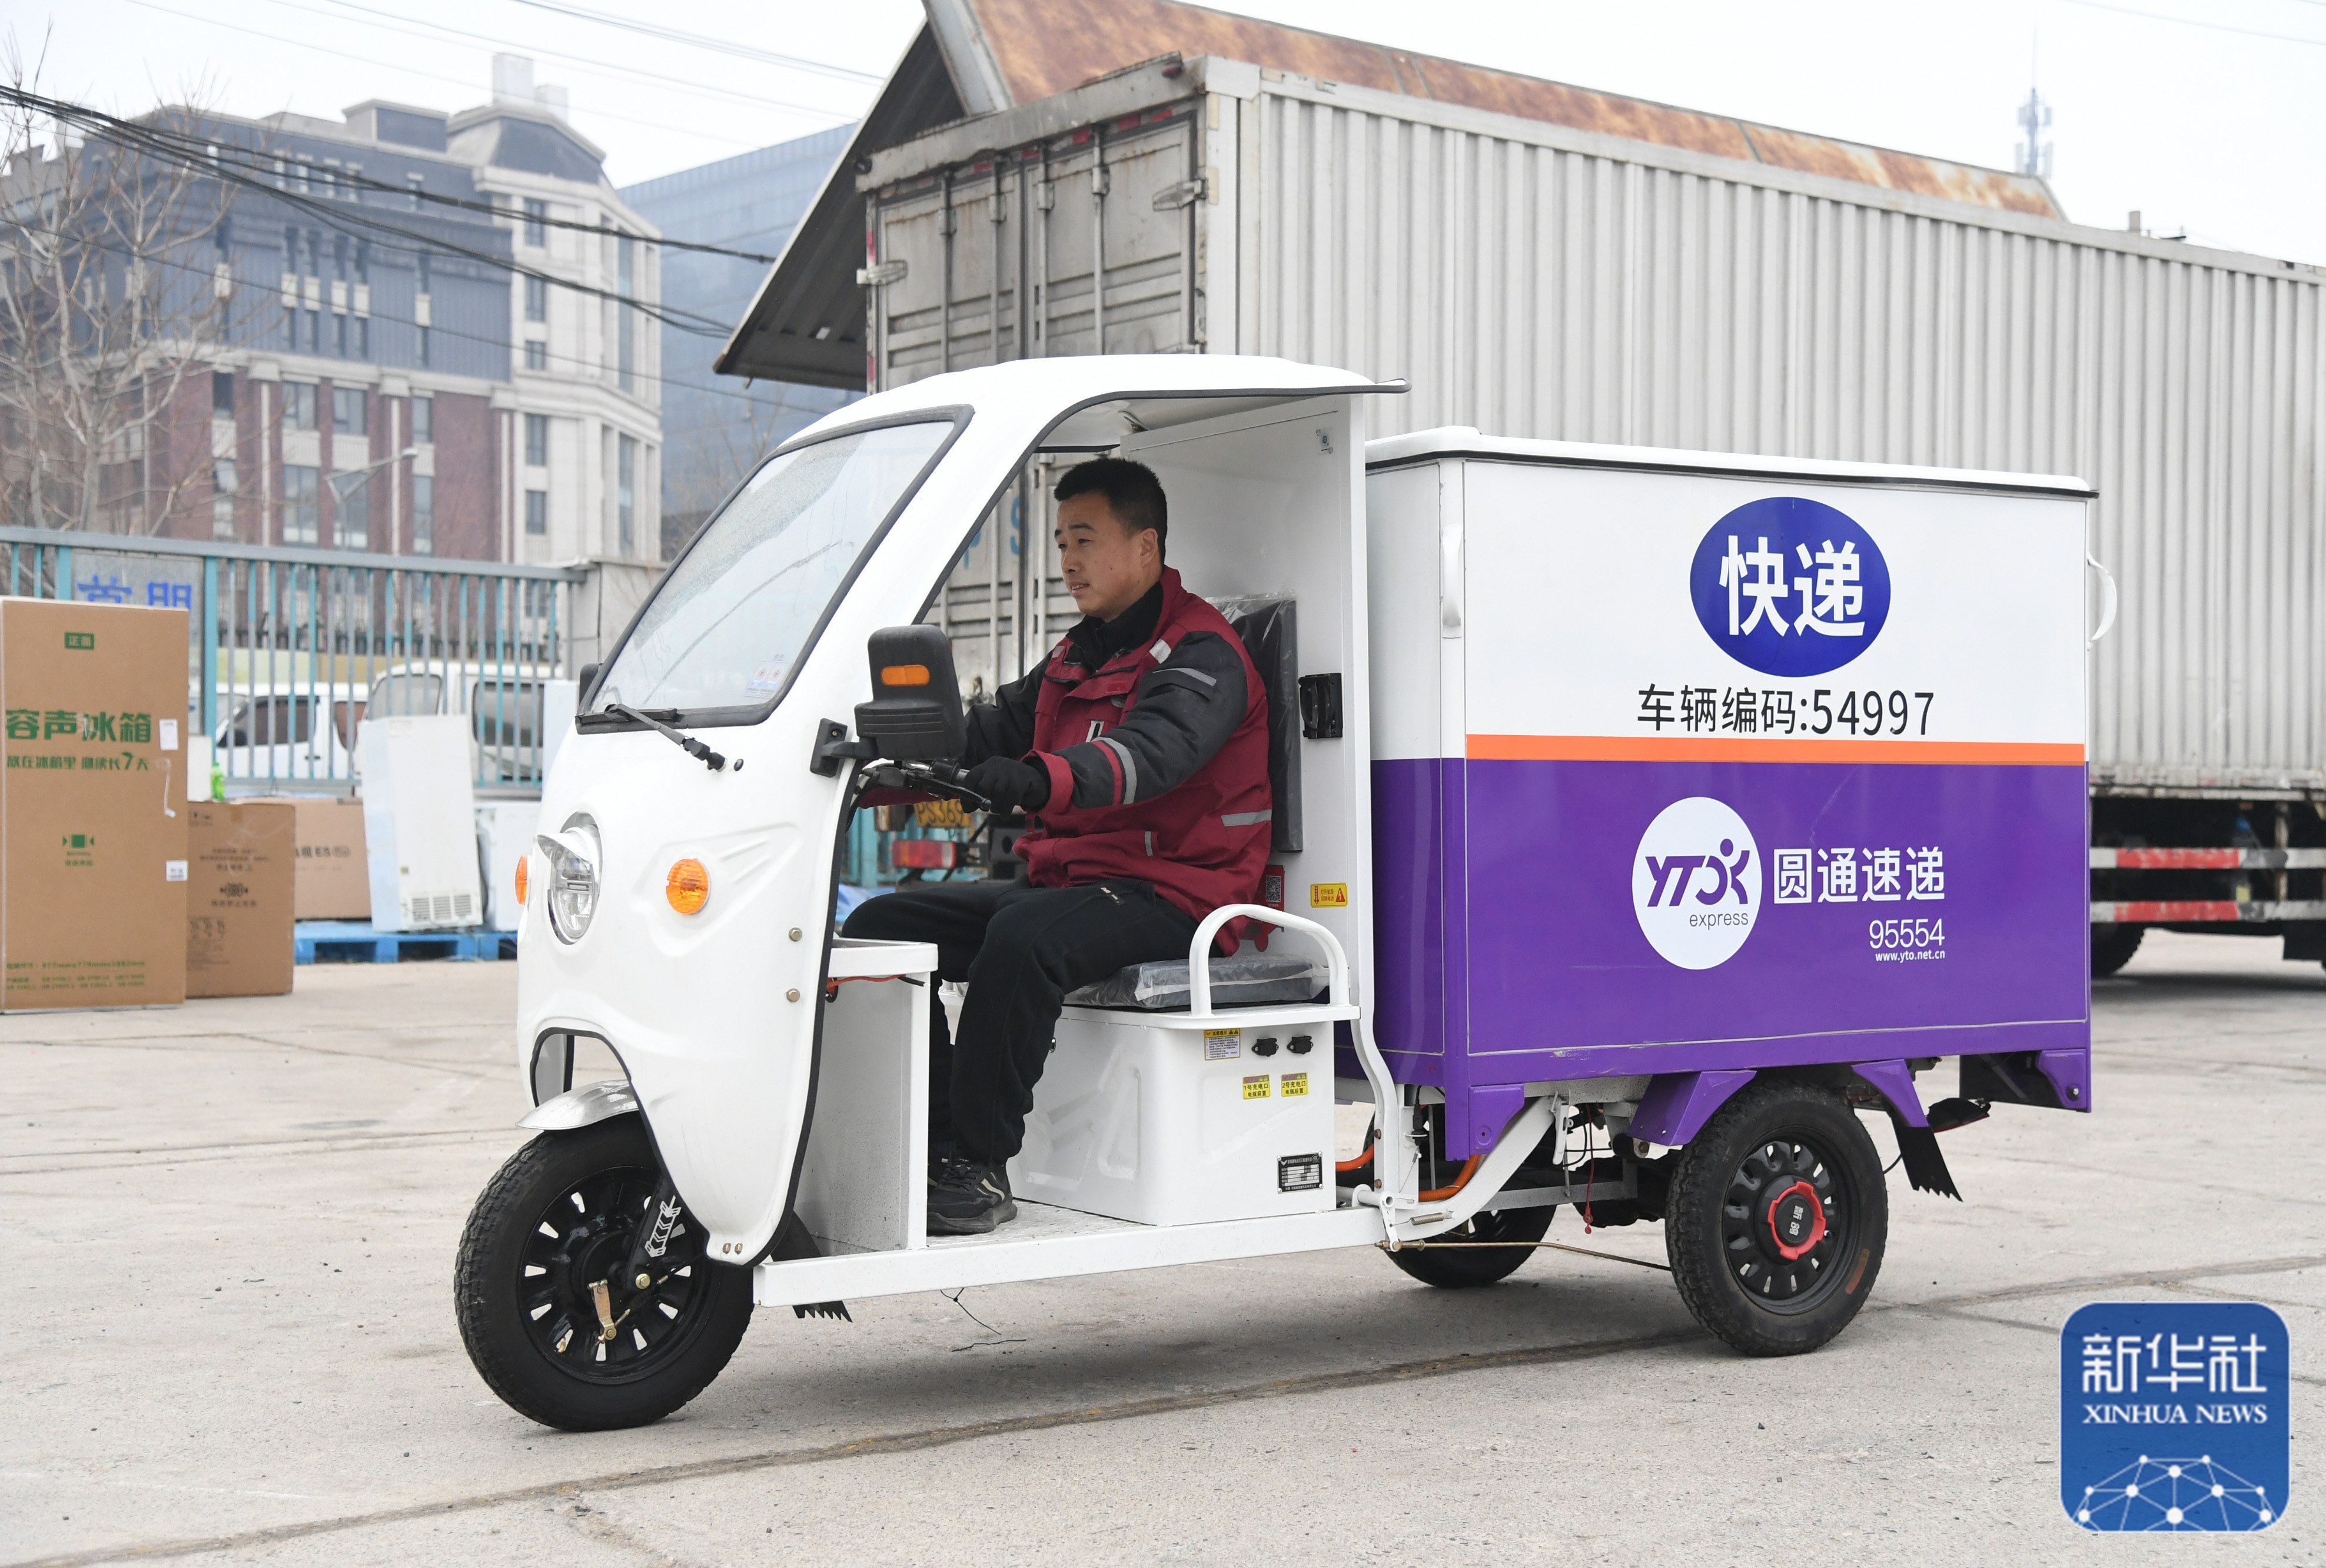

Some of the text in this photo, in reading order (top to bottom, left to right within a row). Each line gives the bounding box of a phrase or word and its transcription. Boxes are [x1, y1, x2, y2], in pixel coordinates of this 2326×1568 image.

[1719, 535, 1865, 637] 快递
[5, 708, 151, 743] 容声冰箱
[1637, 683, 1934, 736] 车辆编码:54997
[1773, 846, 1945, 904] 圆通速递
[1689, 912, 1749, 931] express
[1869, 918, 1945, 949] 95554
[1875, 949, 1945, 964] www.yto.net.cn
